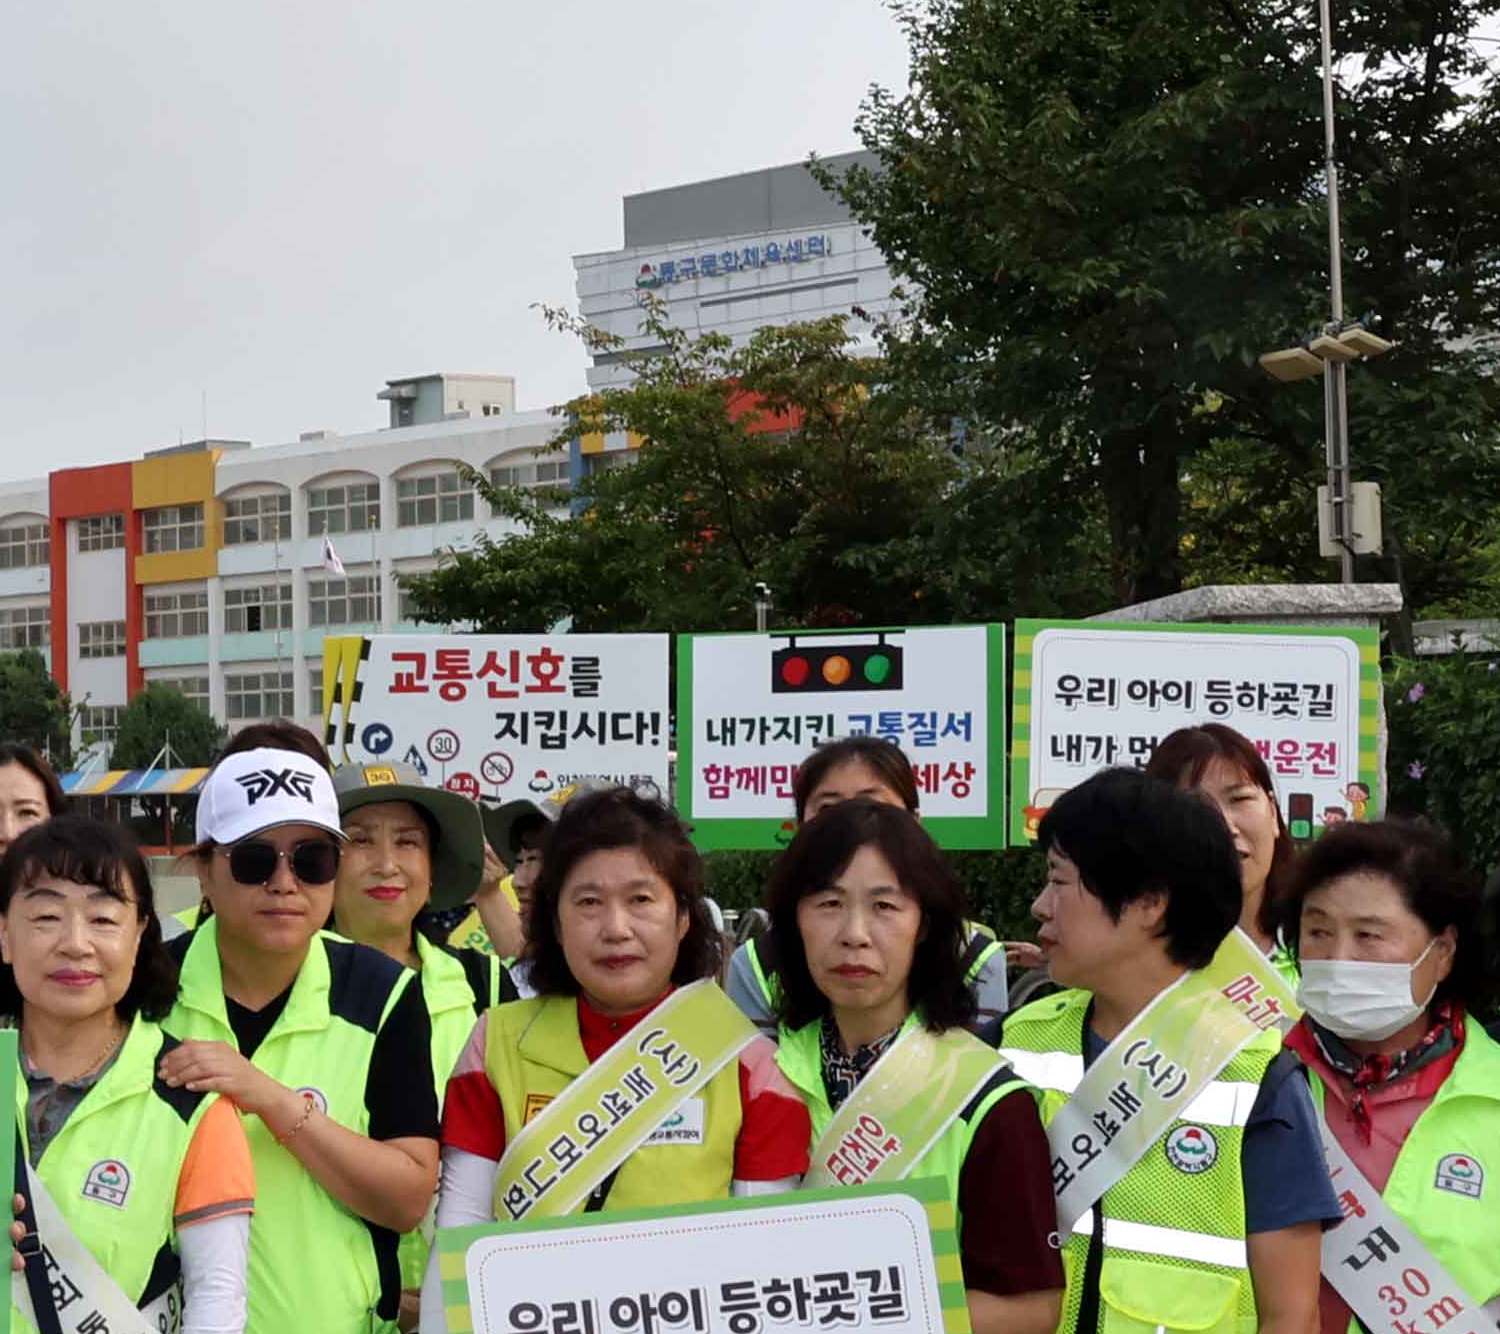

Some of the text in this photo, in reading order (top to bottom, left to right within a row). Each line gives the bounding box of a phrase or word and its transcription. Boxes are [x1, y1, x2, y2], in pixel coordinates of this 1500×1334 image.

[389, 647, 602, 702] 교통신호를
[1055, 675, 1335, 717] 우리 아이 등하굣길
[434, 737, 453, 753] 30
[494, 710, 661, 750] 지킵시다!
[706, 711, 973, 748] 내가지킨 교통질서
[1050, 735, 1121, 764] 내가
[639, 1030, 699, 1085] (사)
[1122, 1039, 1187, 1100] (사)
[719, 1266, 906, 1334] 등하굣길
[1376, 1266, 1431, 1318] 30
